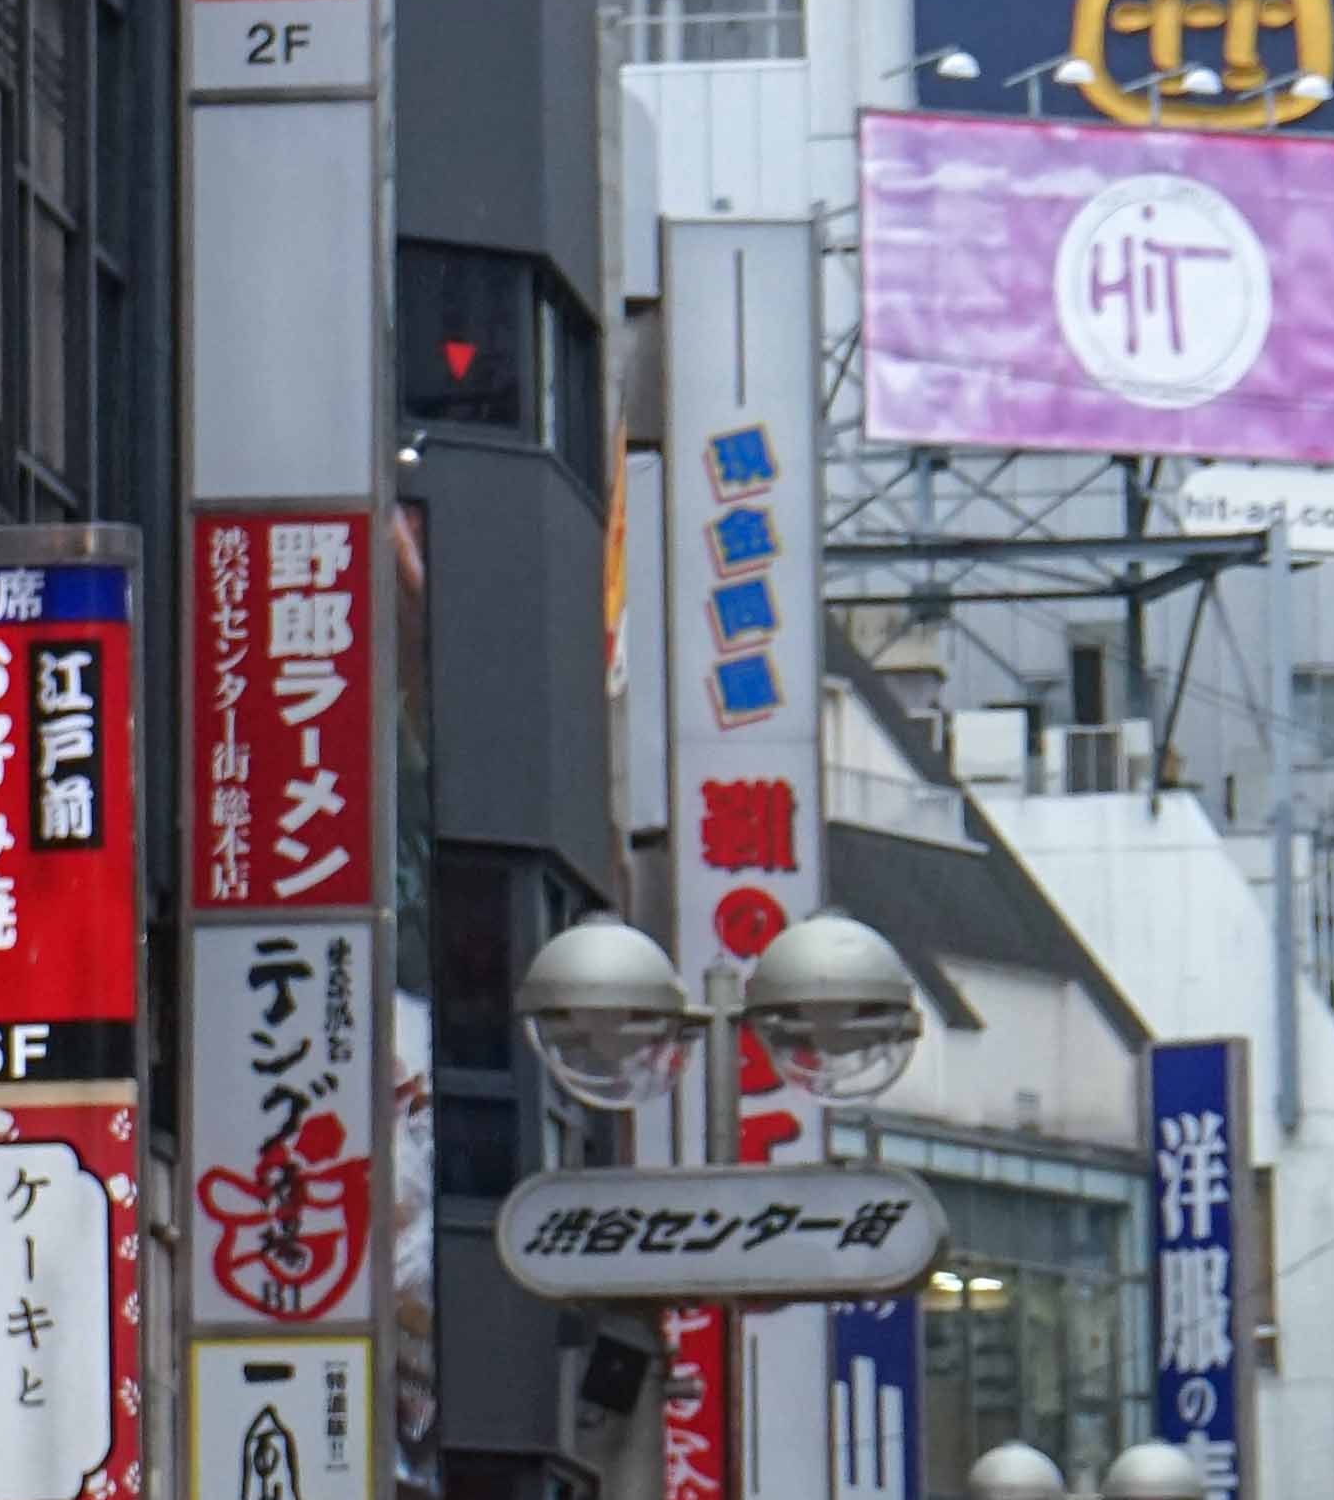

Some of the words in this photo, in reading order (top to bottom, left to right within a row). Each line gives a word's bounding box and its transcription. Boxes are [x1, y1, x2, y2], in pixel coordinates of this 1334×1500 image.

[247, 21, 311, 65] 2F
[35, 652, 95, 842] 江戸前
[267, 522, 355, 900] 野郎ラーメン
[5, 1166, 55, 1412] ケーキと
[523, 1202, 910, 1256] 渋谷センター街
